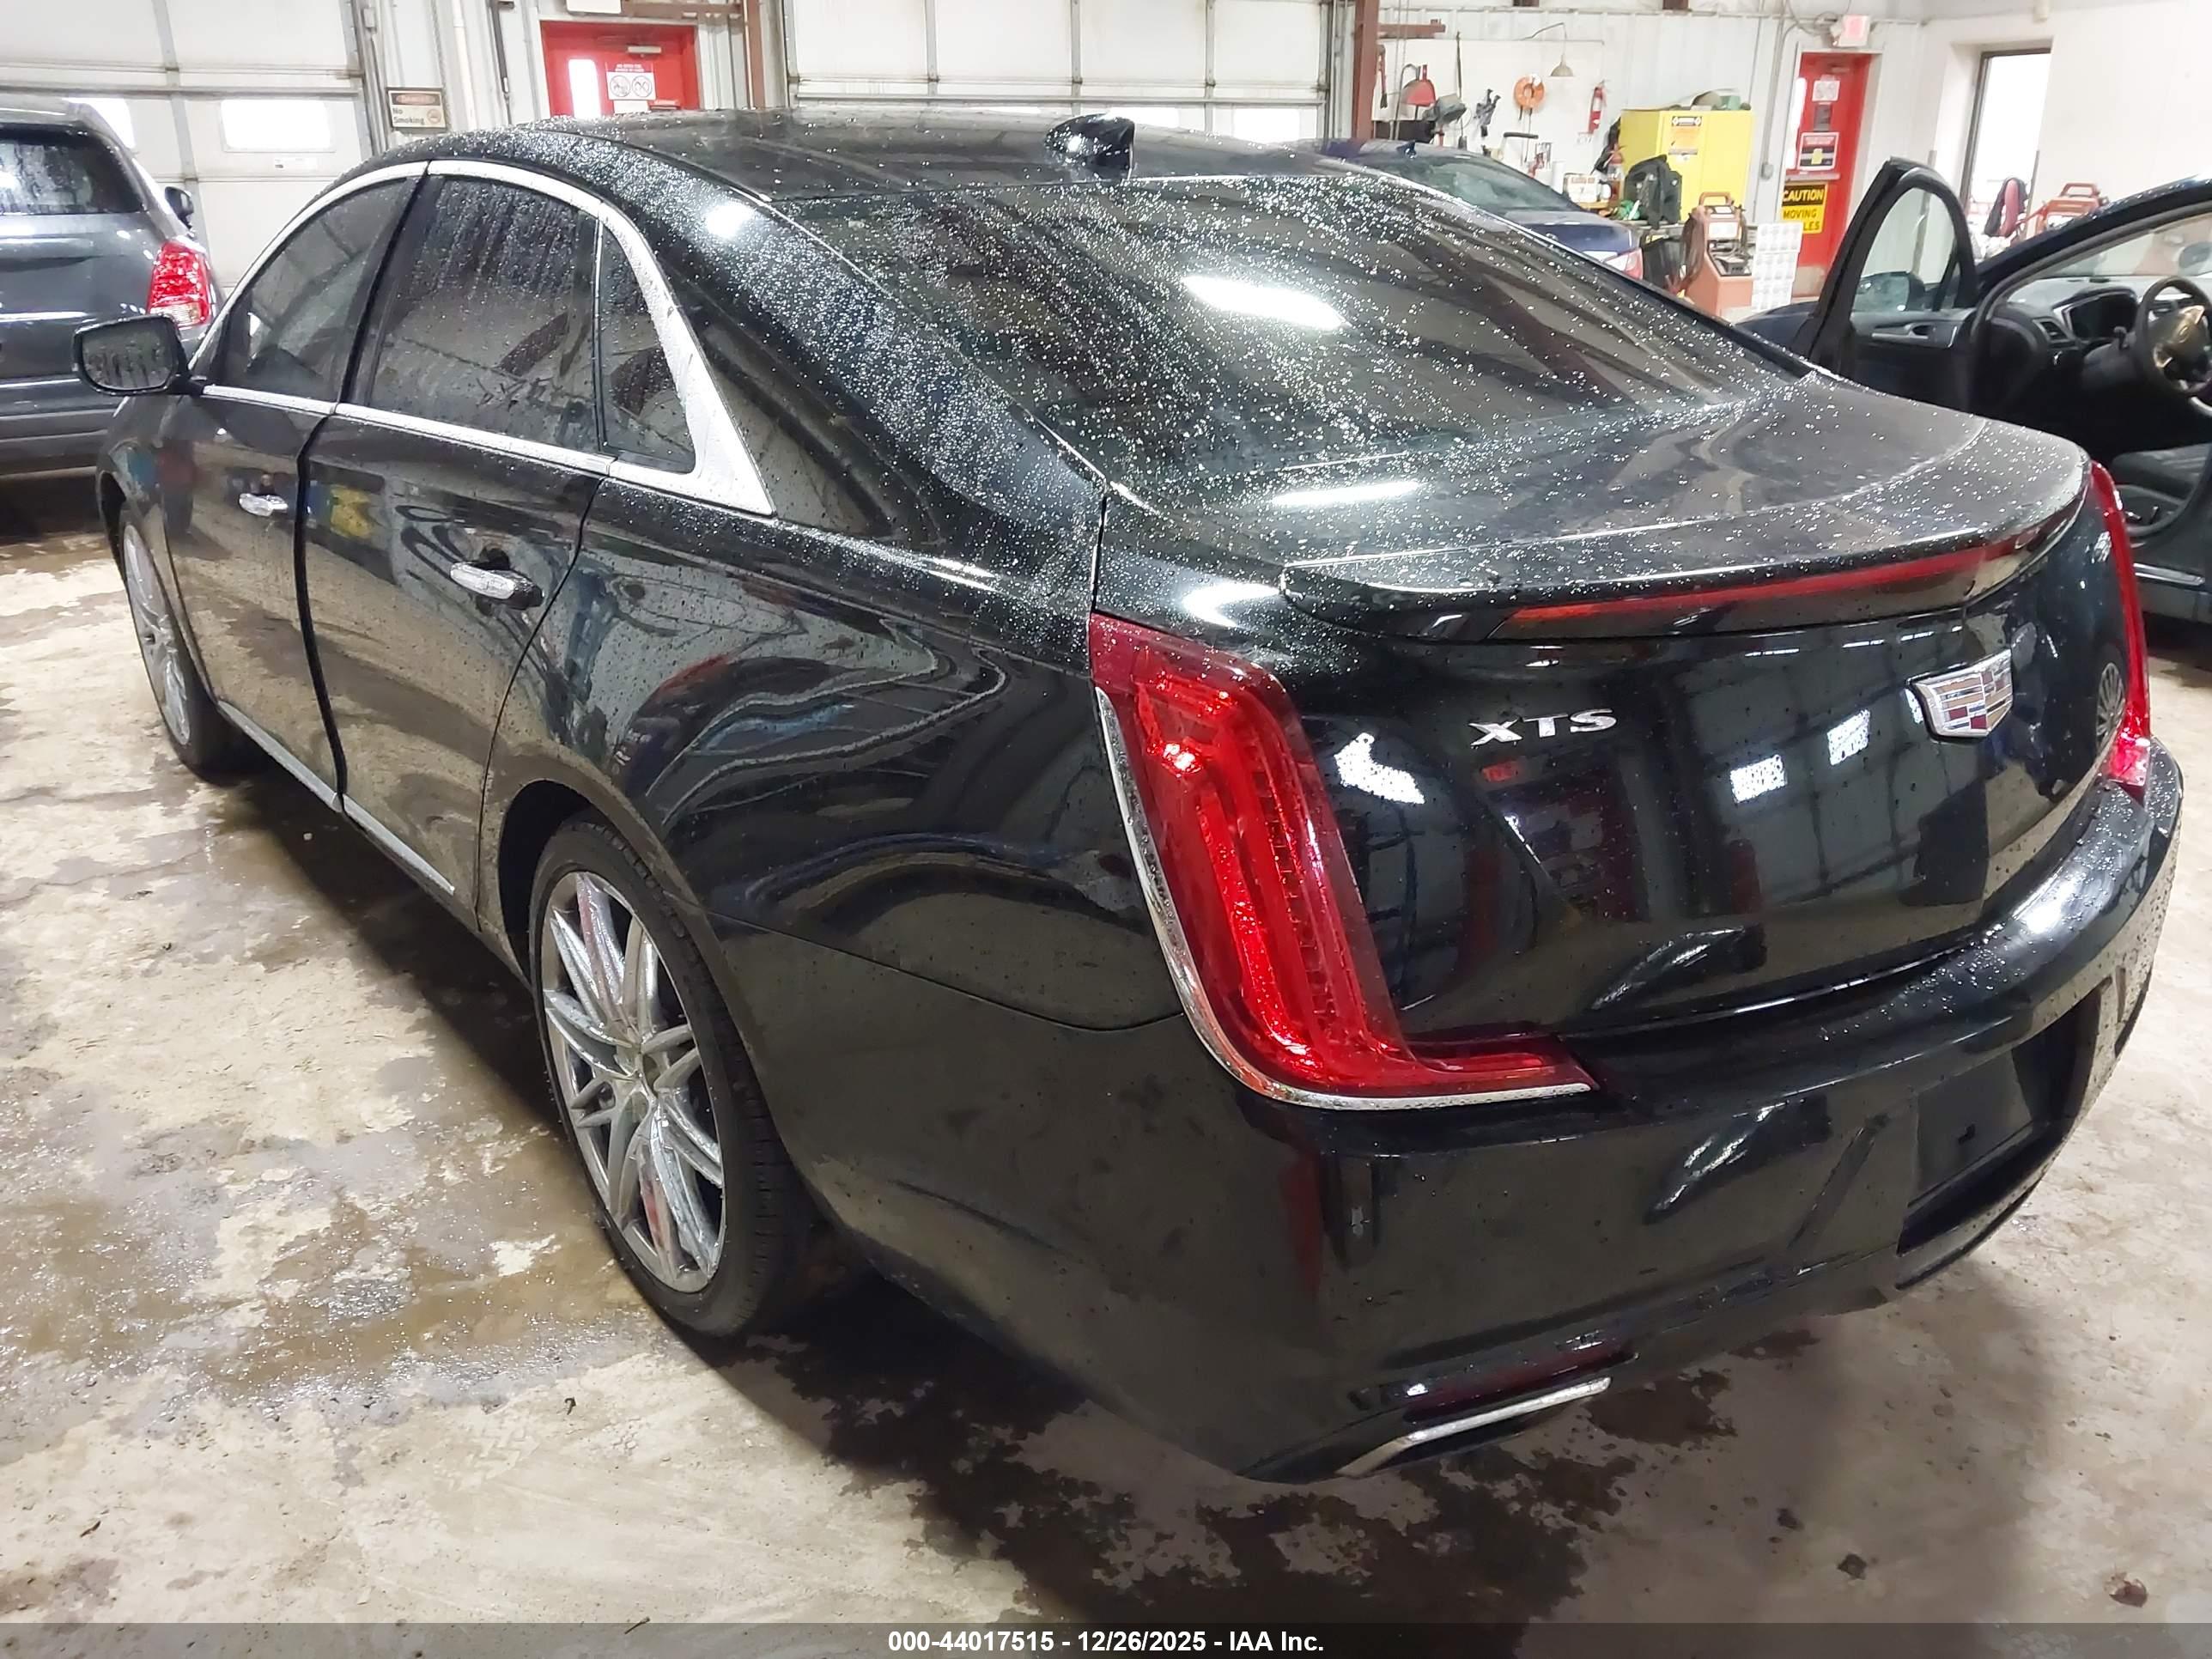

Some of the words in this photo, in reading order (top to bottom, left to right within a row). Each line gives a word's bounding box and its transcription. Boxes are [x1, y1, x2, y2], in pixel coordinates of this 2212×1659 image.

[393, 116, 424, 126] Smoking
[1783, 189, 1825, 202] CAUTION
[1783, 209, 1817, 219] MOVING
[1468, 708, 1617, 746] XTS
